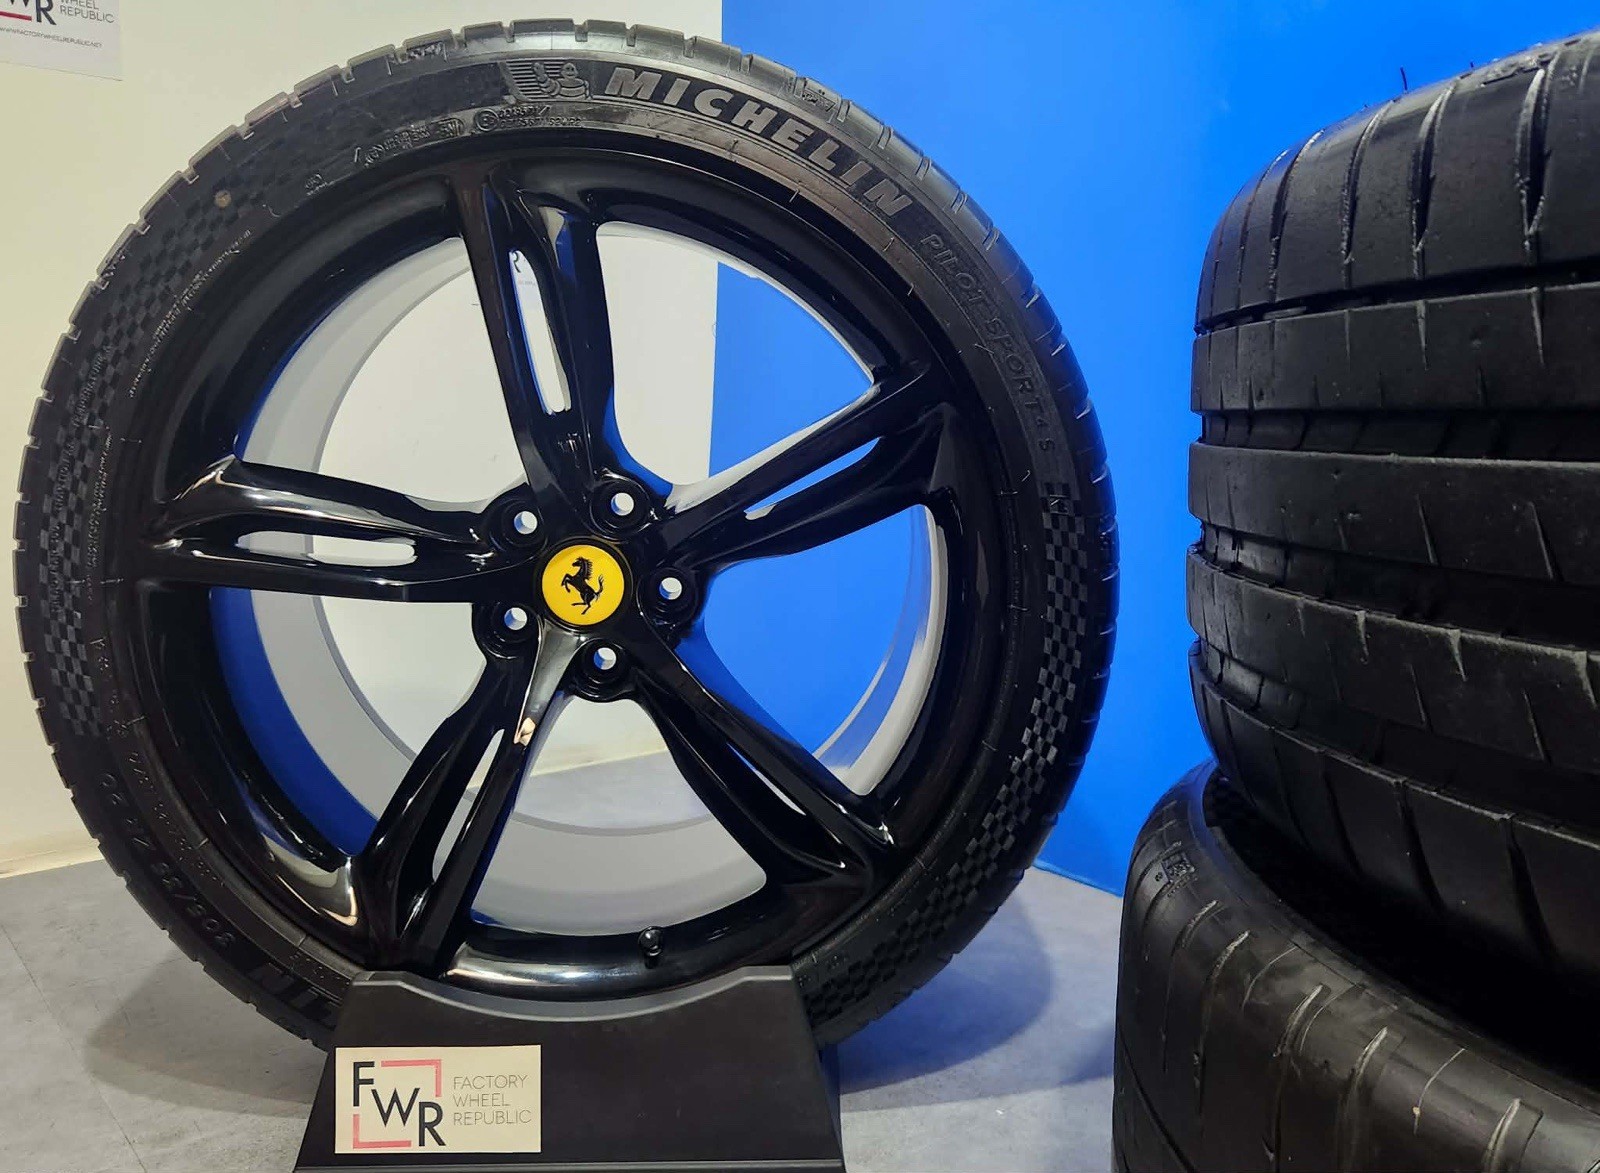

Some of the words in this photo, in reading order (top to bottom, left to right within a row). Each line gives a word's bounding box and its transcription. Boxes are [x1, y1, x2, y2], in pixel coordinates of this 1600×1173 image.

[60, 5, 115, 23] REPUBLIC
[605, 67, 913, 217] MICHELIN
[920, 233, 987, 303] PILOT
[984, 315, 1044, 413] SPORT
[453, 1075, 528, 1090] FACTORY
[353, 1061, 446, 1147] FWR
[453, 1093, 511, 1107] WHEEL
[453, 1110, 532, 1126] REPUBLIC
